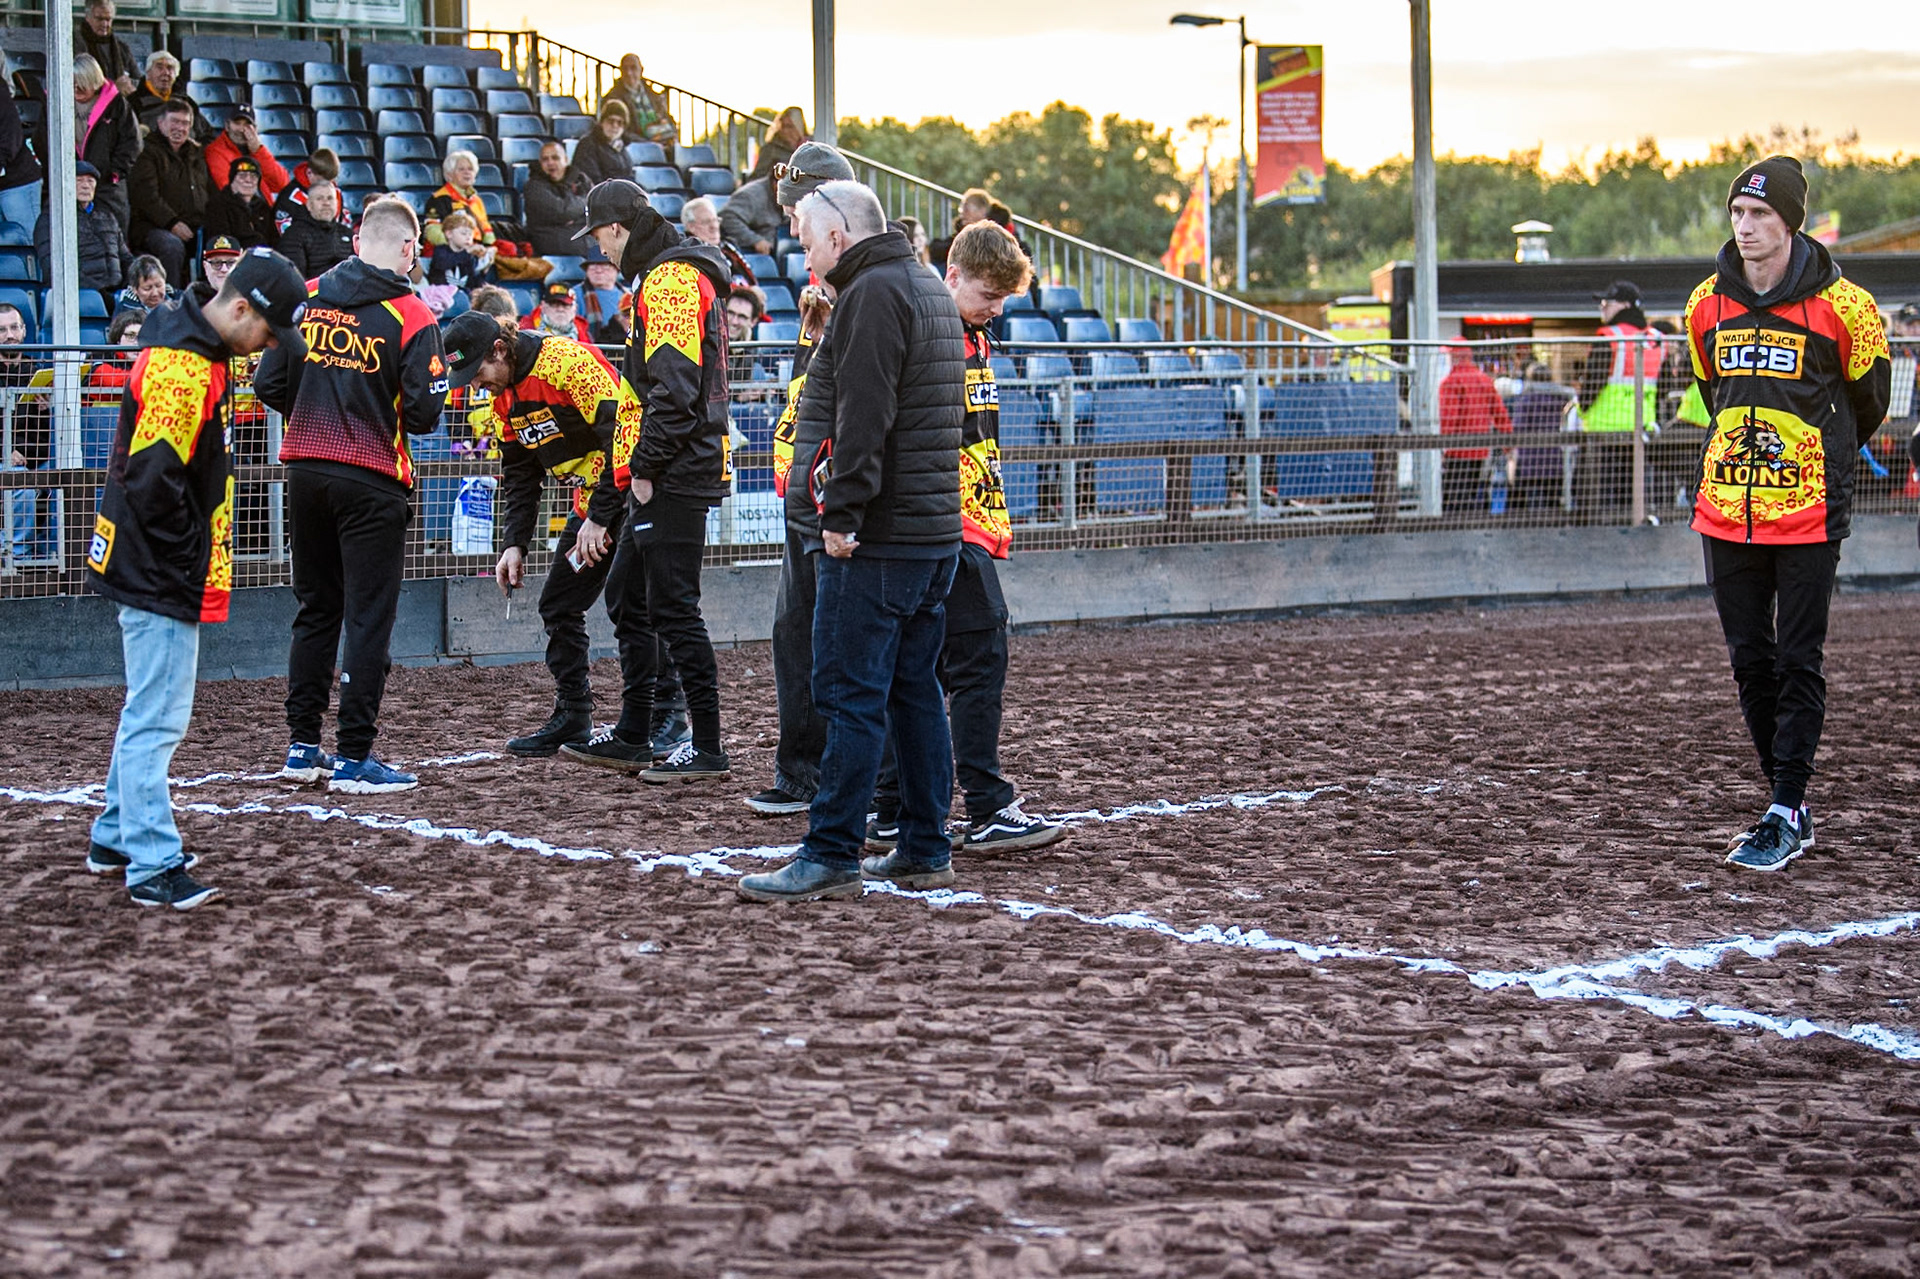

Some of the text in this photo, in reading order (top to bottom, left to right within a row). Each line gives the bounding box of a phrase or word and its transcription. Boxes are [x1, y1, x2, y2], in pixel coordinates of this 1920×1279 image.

[1740, 187, 1766, 198] BETARD
[304, 308, 361, 328] LEICESTER
[299, 322, 386, 374] LIONS
[1722, 333, 1797, 347] WATLING JCB
[323, 353, 368, 374] SPEEDWAY
[1720, 345, 1796, 373] JCB
[1711, 462, 1798, 487] LIONS
